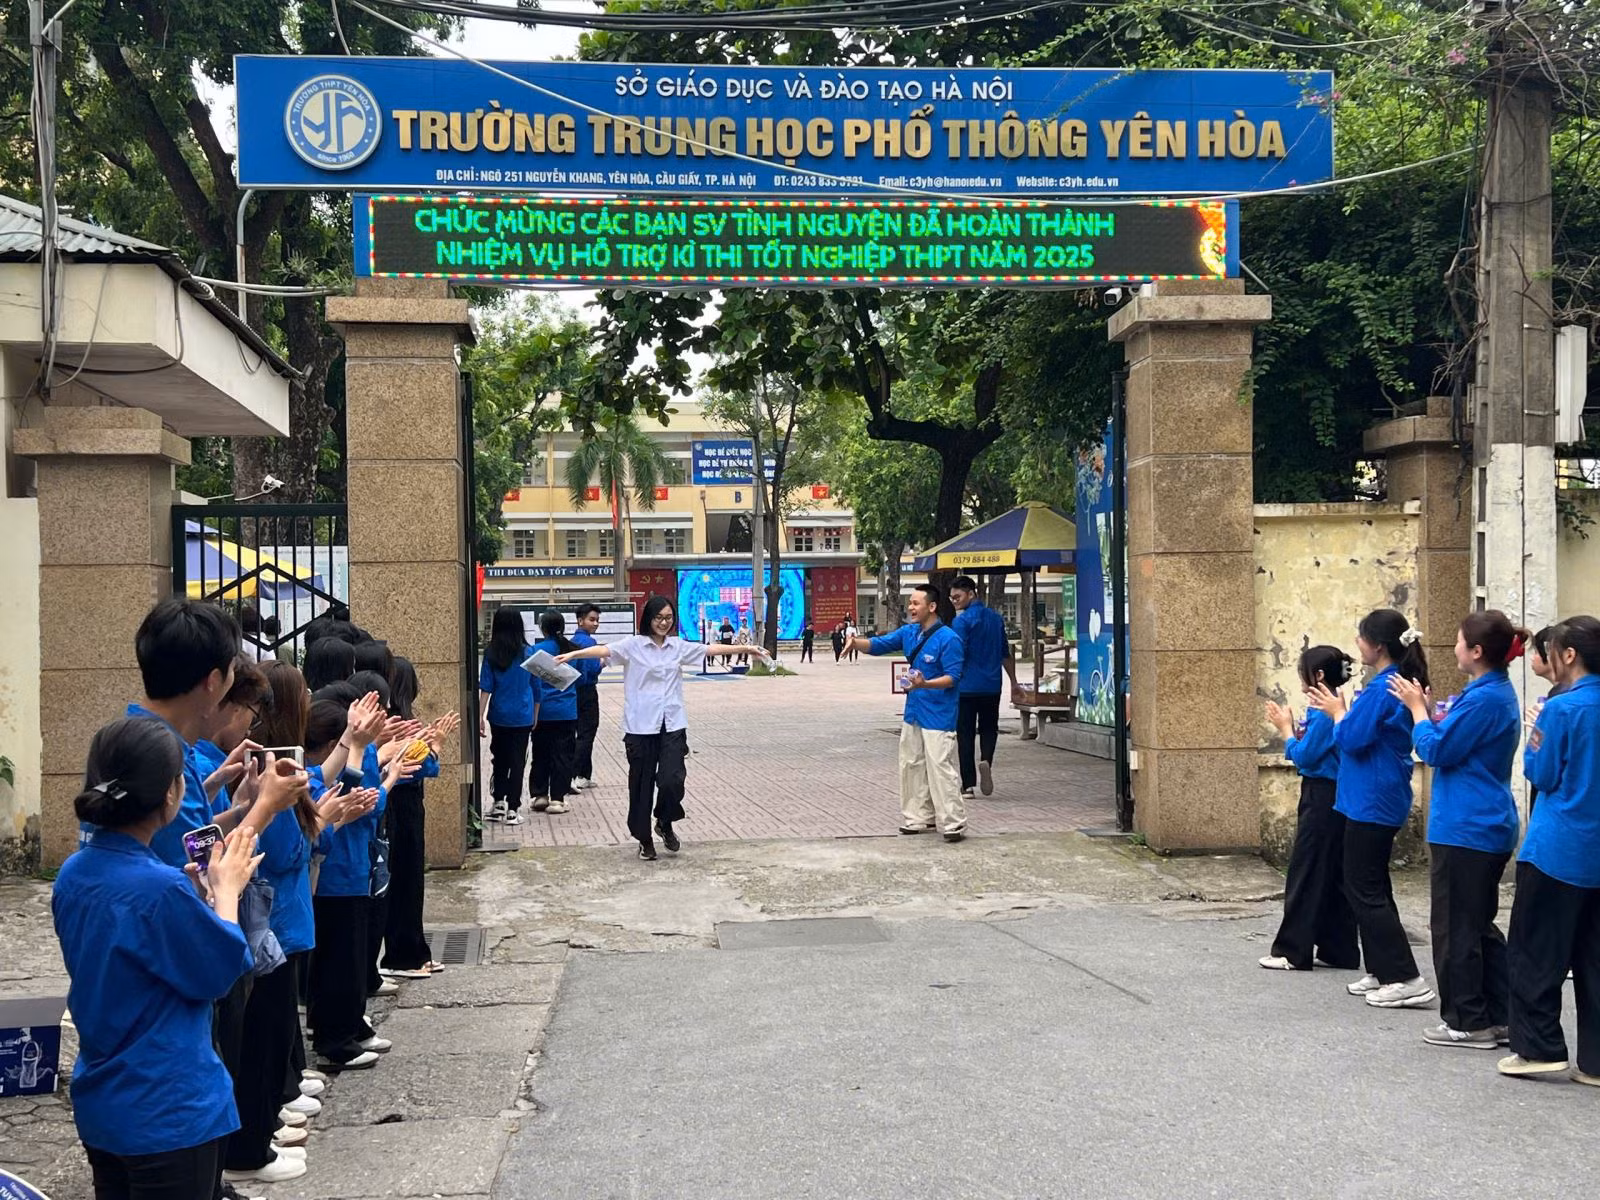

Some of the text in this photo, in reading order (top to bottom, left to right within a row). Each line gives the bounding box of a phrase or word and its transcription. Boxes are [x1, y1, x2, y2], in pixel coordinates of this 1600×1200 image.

[615, 69, 1012, 106] SỞ GIÁO DỤC VÀ ĐÀO TẠO HÀ NỘI
[392, 100, 1286, 166] TRƯỜNG TRUNG HỌC PHỔ THÔNG YÊN HÒA
[436, 169, 454, 184] ĐỊA
[504, 170, 523, 183] 251
[525, 167, 566, 183] NGUYỄN
[568, 172, 607, 185] KHANG,
[608, 170, 627, 184] YÊN
[630, 171, 654, 186] HÒA,
[656, 170, 676, 185] CẦU
[678, 170, 702, 187] GIẤY,
[705, 174, 720, 186] TP.
[722, 171, 735, 186] HÀ
[739, 172, 756, 189] NỘI
[791, 175, 816, 187] 0243
[879, 176, 908, 187] Email:
[1016, 176, 1119, 188] Website: c3yh.edu.vn
[414, 204, 1115, 241] CHÚC MỪNG CÁC BẠN SV TÌNH NGUYỆN ĐÃ HOÀN THÀNH
[436, 237, 1095, 273] NHIỆM VỤ HỖ TRỢ KÌ THI TỐT NGHIỆP THPT NĂM 2025
[735, 491, 742, 503] B
[488, 568, 504, 576] THI
[549, 566, 567, 576] TỐT
[576, 567, 595, 577] HỌC
